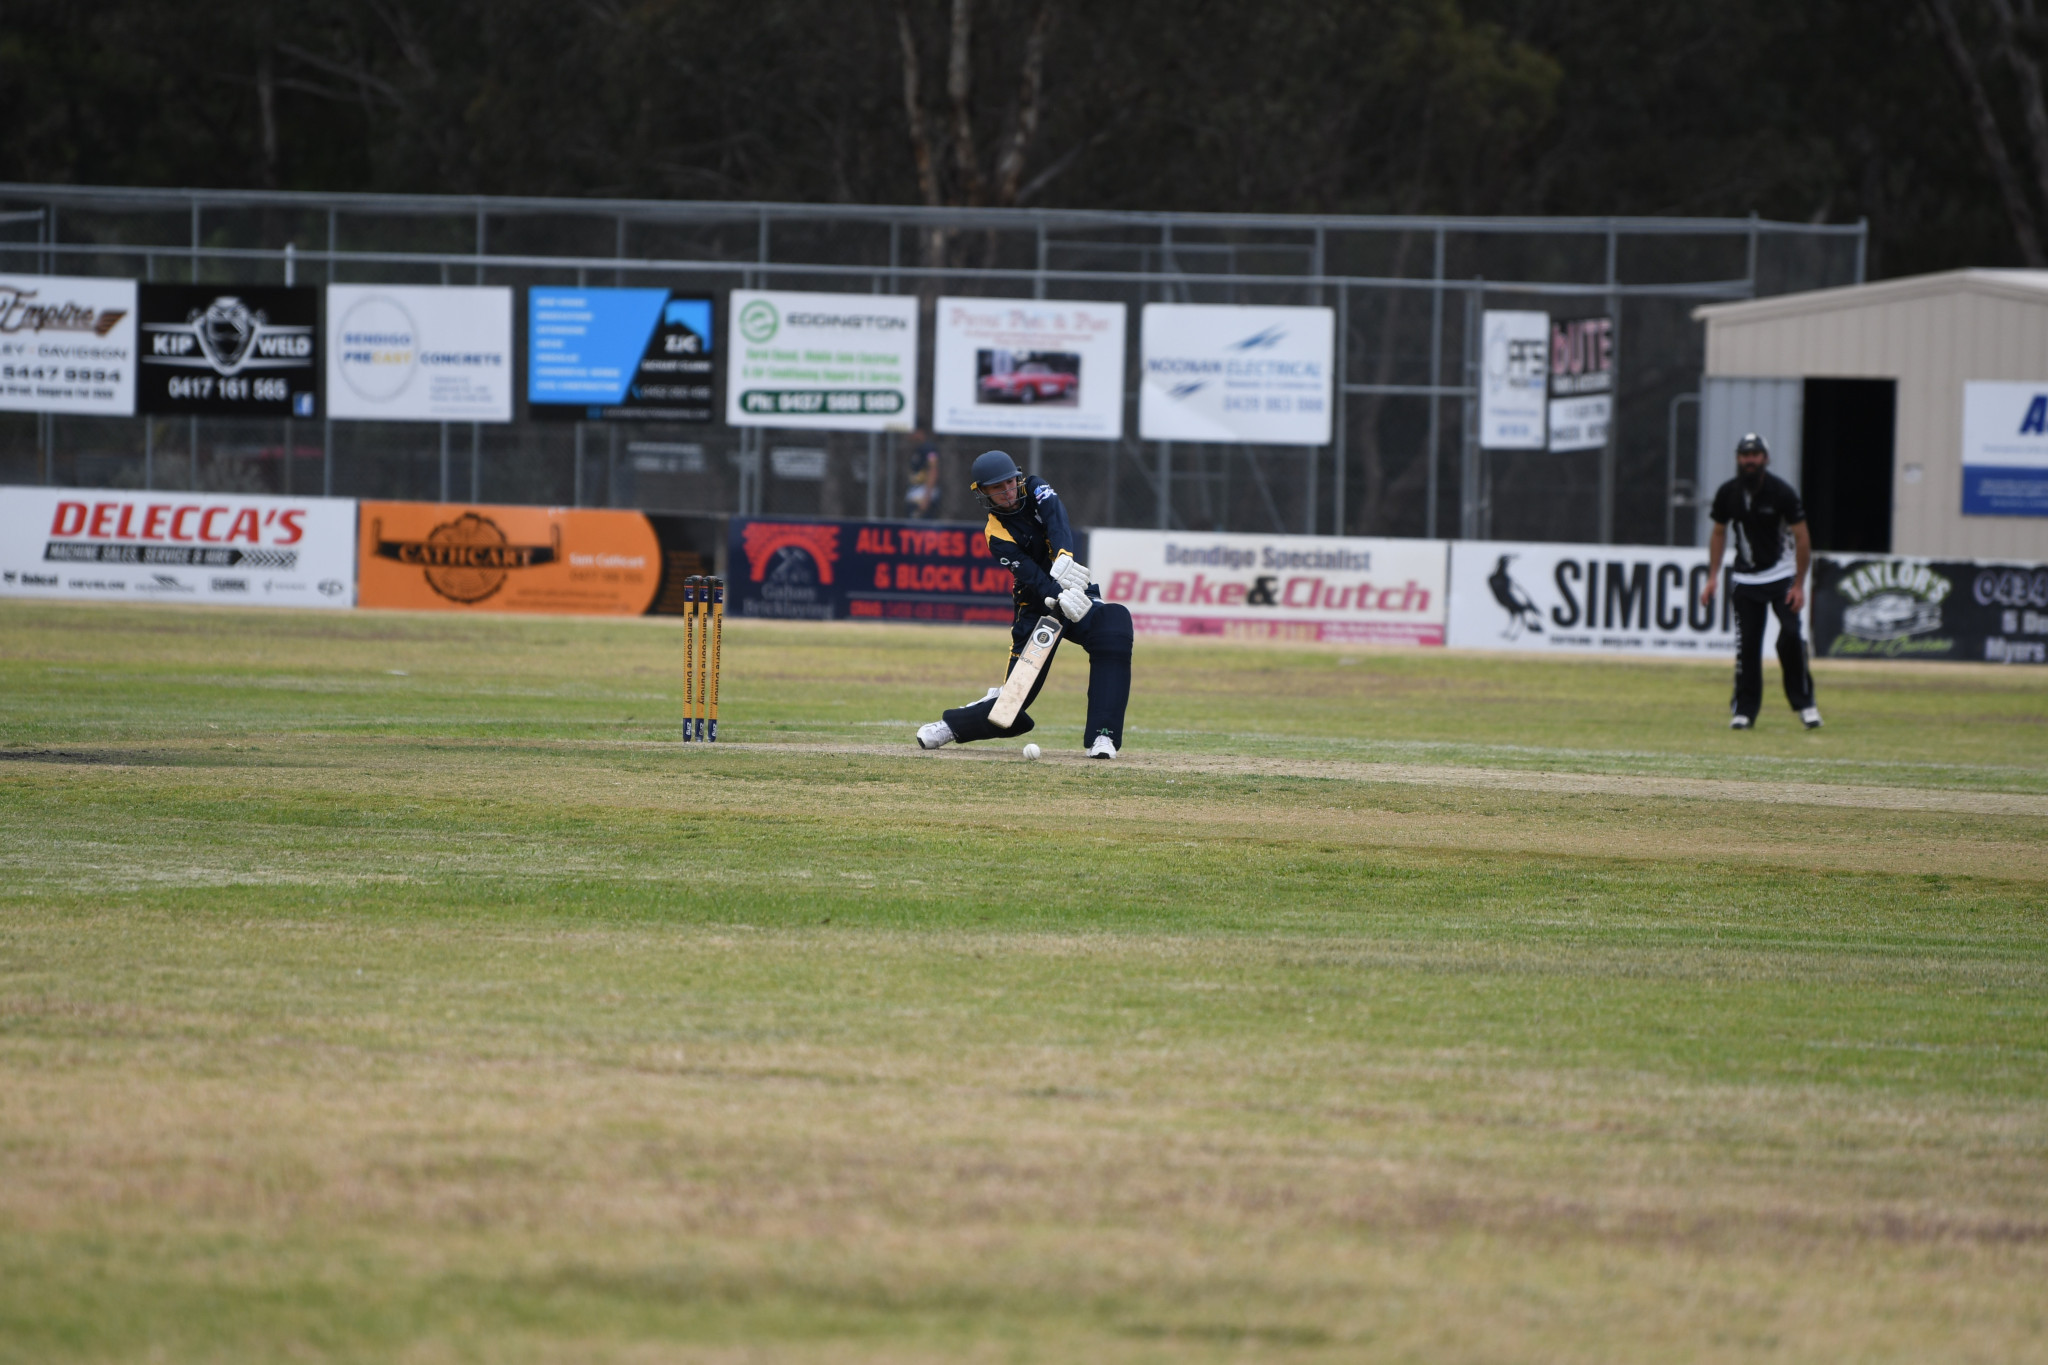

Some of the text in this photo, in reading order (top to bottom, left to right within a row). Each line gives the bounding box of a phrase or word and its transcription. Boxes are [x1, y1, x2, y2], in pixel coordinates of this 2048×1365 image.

[786, 312, 908, 331] EDDINGTON
[153, 333, 312, 357] KIP WELD
[344, 332, 411, 346] BENDIGO
[37, 344, 128, 361] DAVIDSON
[344, 352, 502, 367] PRECAST CONCRETE
[1225, 358, 1322, 378] ELECTRICAL
[168, 375, 214, 399] 0417
[217, 376, 249, 400] 161
[51, 501, 307, 544] DELECCA'S
[856, 528, 896, 555] ALL
[898, 529, 966, 557] TYPES
[399, 544, 531, 568] CATHCART
[595, 552, 645, 569] Cathcart
[1164, 543, 1371, 571] Bendigo Specialist
[21, 570, 59, 586] Bobcat
[874, 562, 891, 589] &
[896, 564, 966, 591] BLOCK
[1838, 561, 1952, 604] TAYLOR'S
[1985, 636, 2046, 664] Myers
